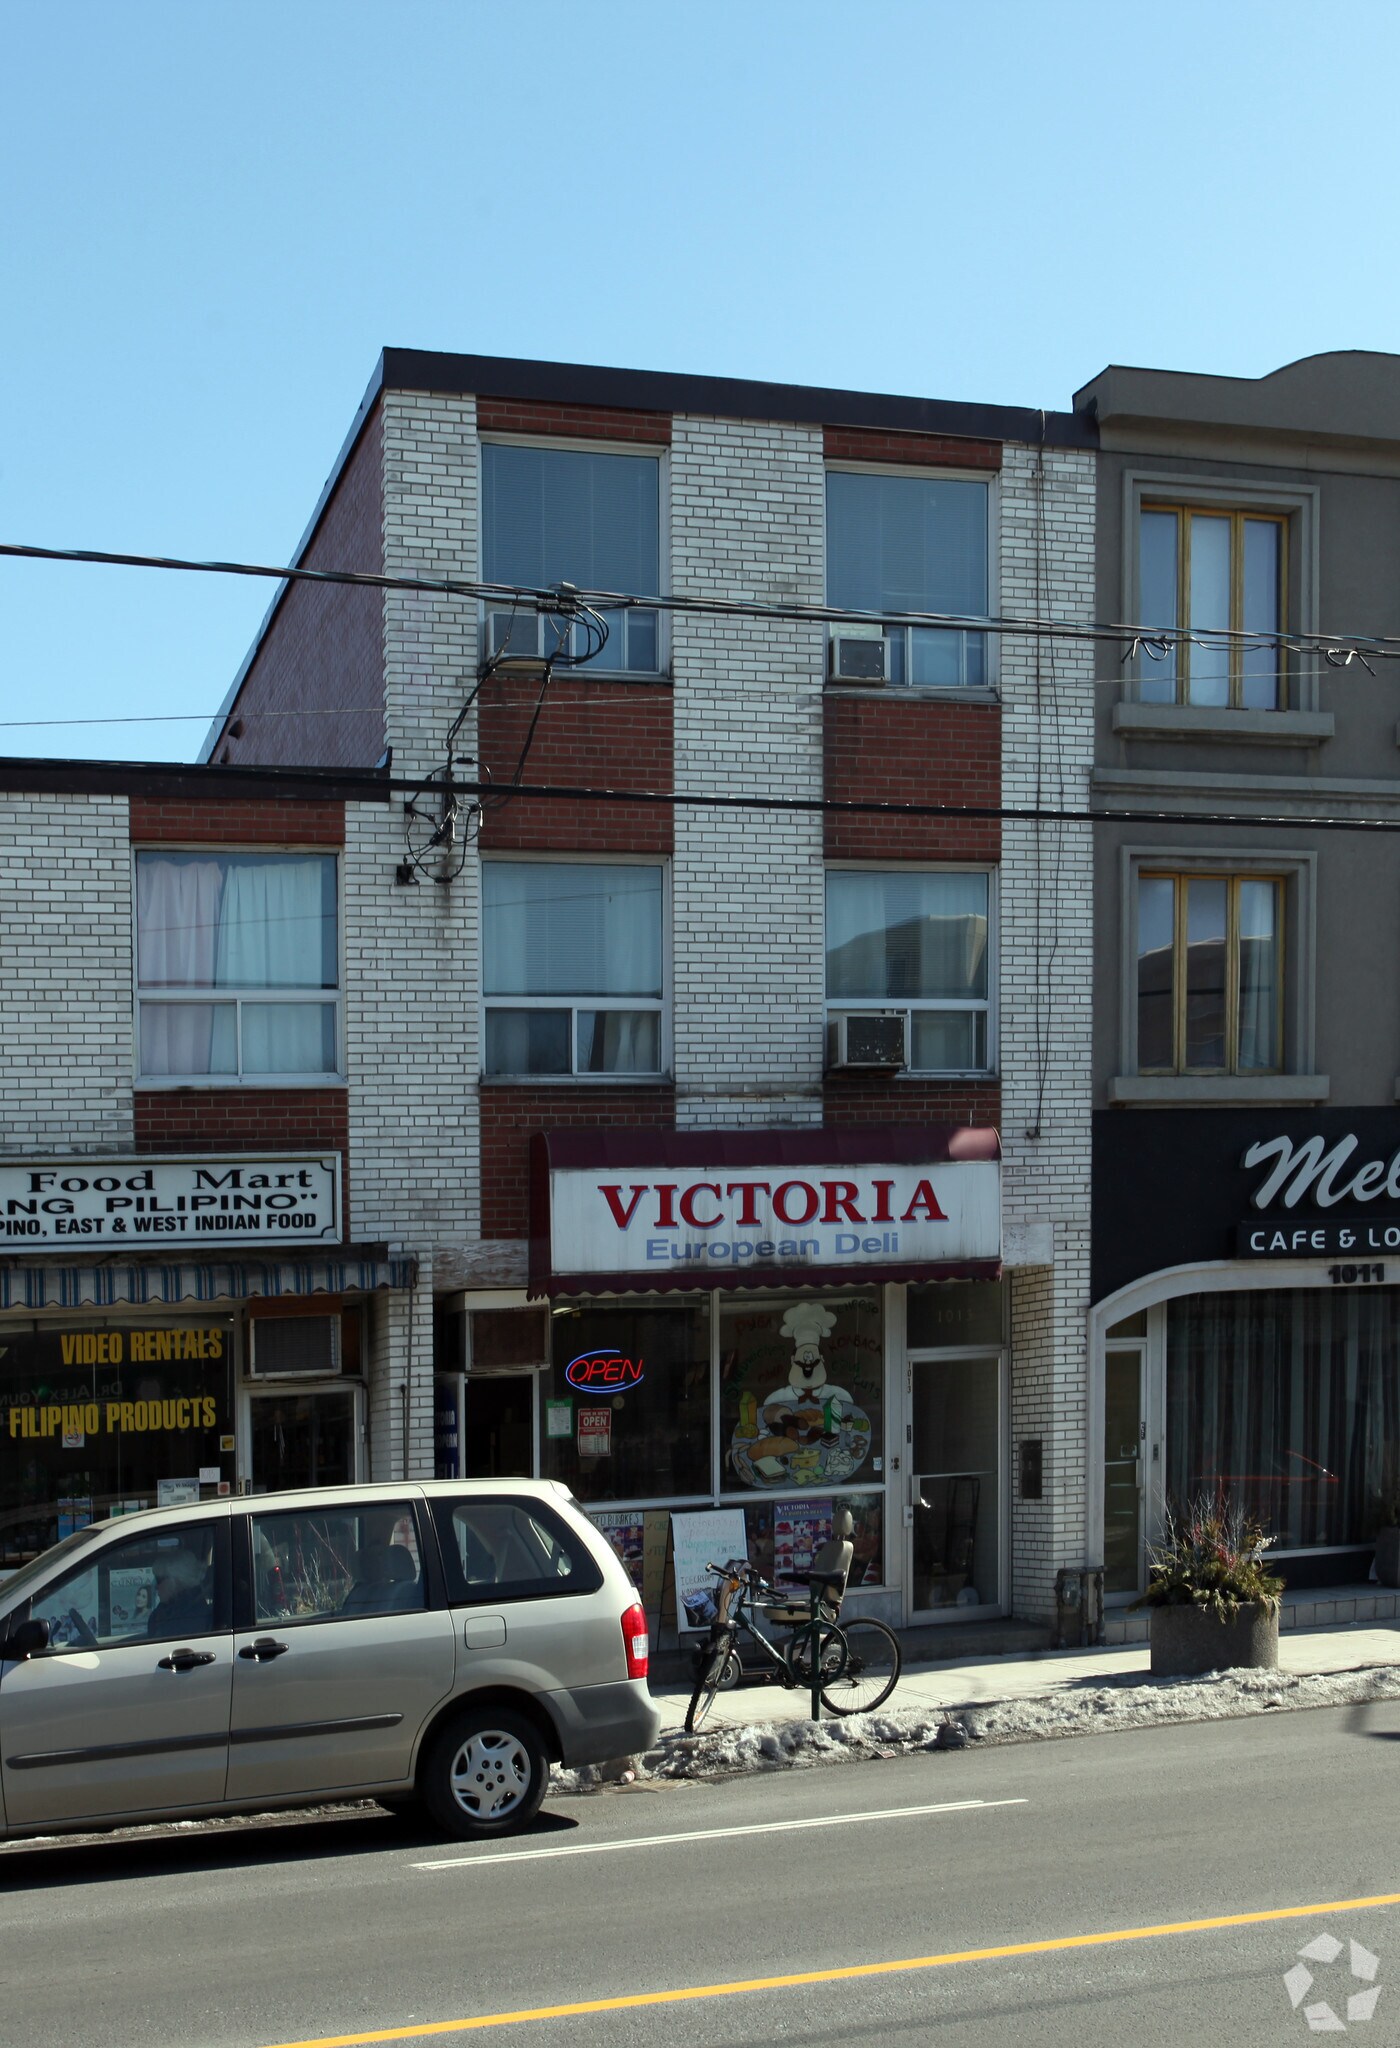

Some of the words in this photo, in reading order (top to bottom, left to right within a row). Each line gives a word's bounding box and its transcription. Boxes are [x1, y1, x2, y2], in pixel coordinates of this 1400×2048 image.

[27, 1169, 156, 1193] Food
[192, 1169, 312, 1190] Mart
[0, 1198, 75, 1215] NG
[597, 1179, 949, 1231] VICTORIA
[55, 1218, 104, 1234] EAST
[111, 1217, 127, 1233] &
[134, 1215, 188, 1232] WEST
[195, 1213, 260, 1231] INDIAN
[267, 1212, 316, 1229] FOOD
[645, 1233, 820, 1263] European
[834, 1232, 899, 1255] Deli
[1250, 1230, 1326, 1251] CAFE
[1339, 1228, 1357, 1249] &
[1328, 1263, 1385, 1284] 1011
[61, 1332, 123, 1365] VIDEO
[130, 1327, 223, 1361] RENTALS
[569, 1359, 643, 1382] OPEN
[9, 1404, 100, 1439] FILIPINO
[106, 1396, 217, 1434] PRODUCTS
[583, 1416, 607, 1427] OPEN
